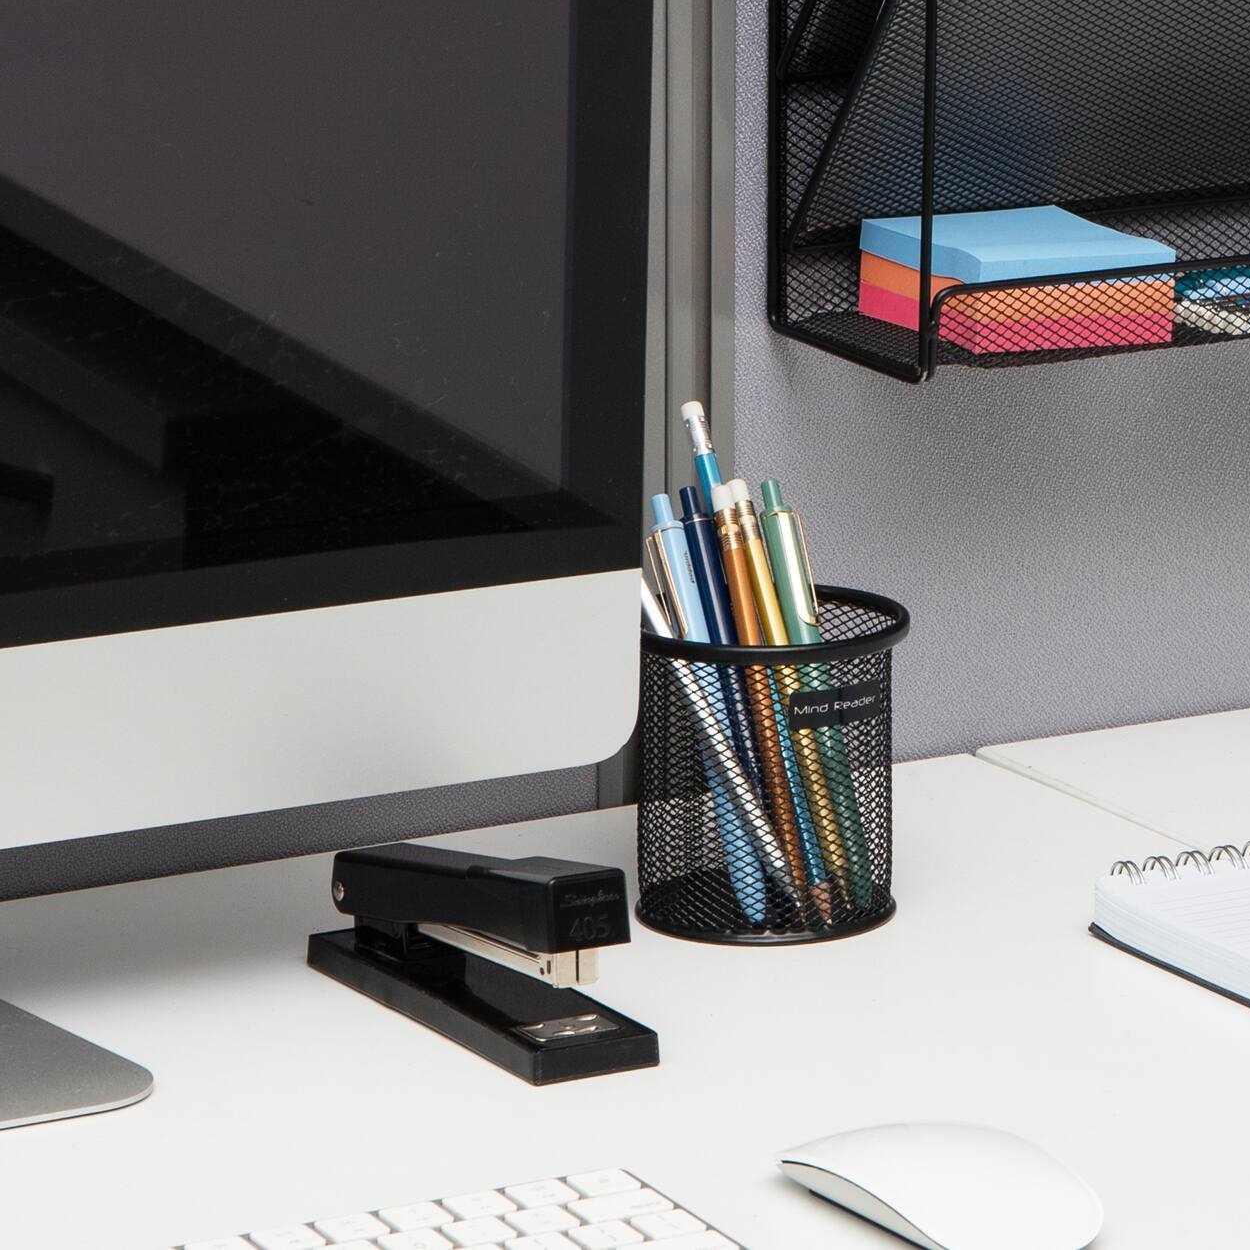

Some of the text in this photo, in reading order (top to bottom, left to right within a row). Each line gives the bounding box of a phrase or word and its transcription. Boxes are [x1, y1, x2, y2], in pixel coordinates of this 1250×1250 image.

[794, 695, 876, 715] Mind Reader
[569, 914, 610, 942] 405
